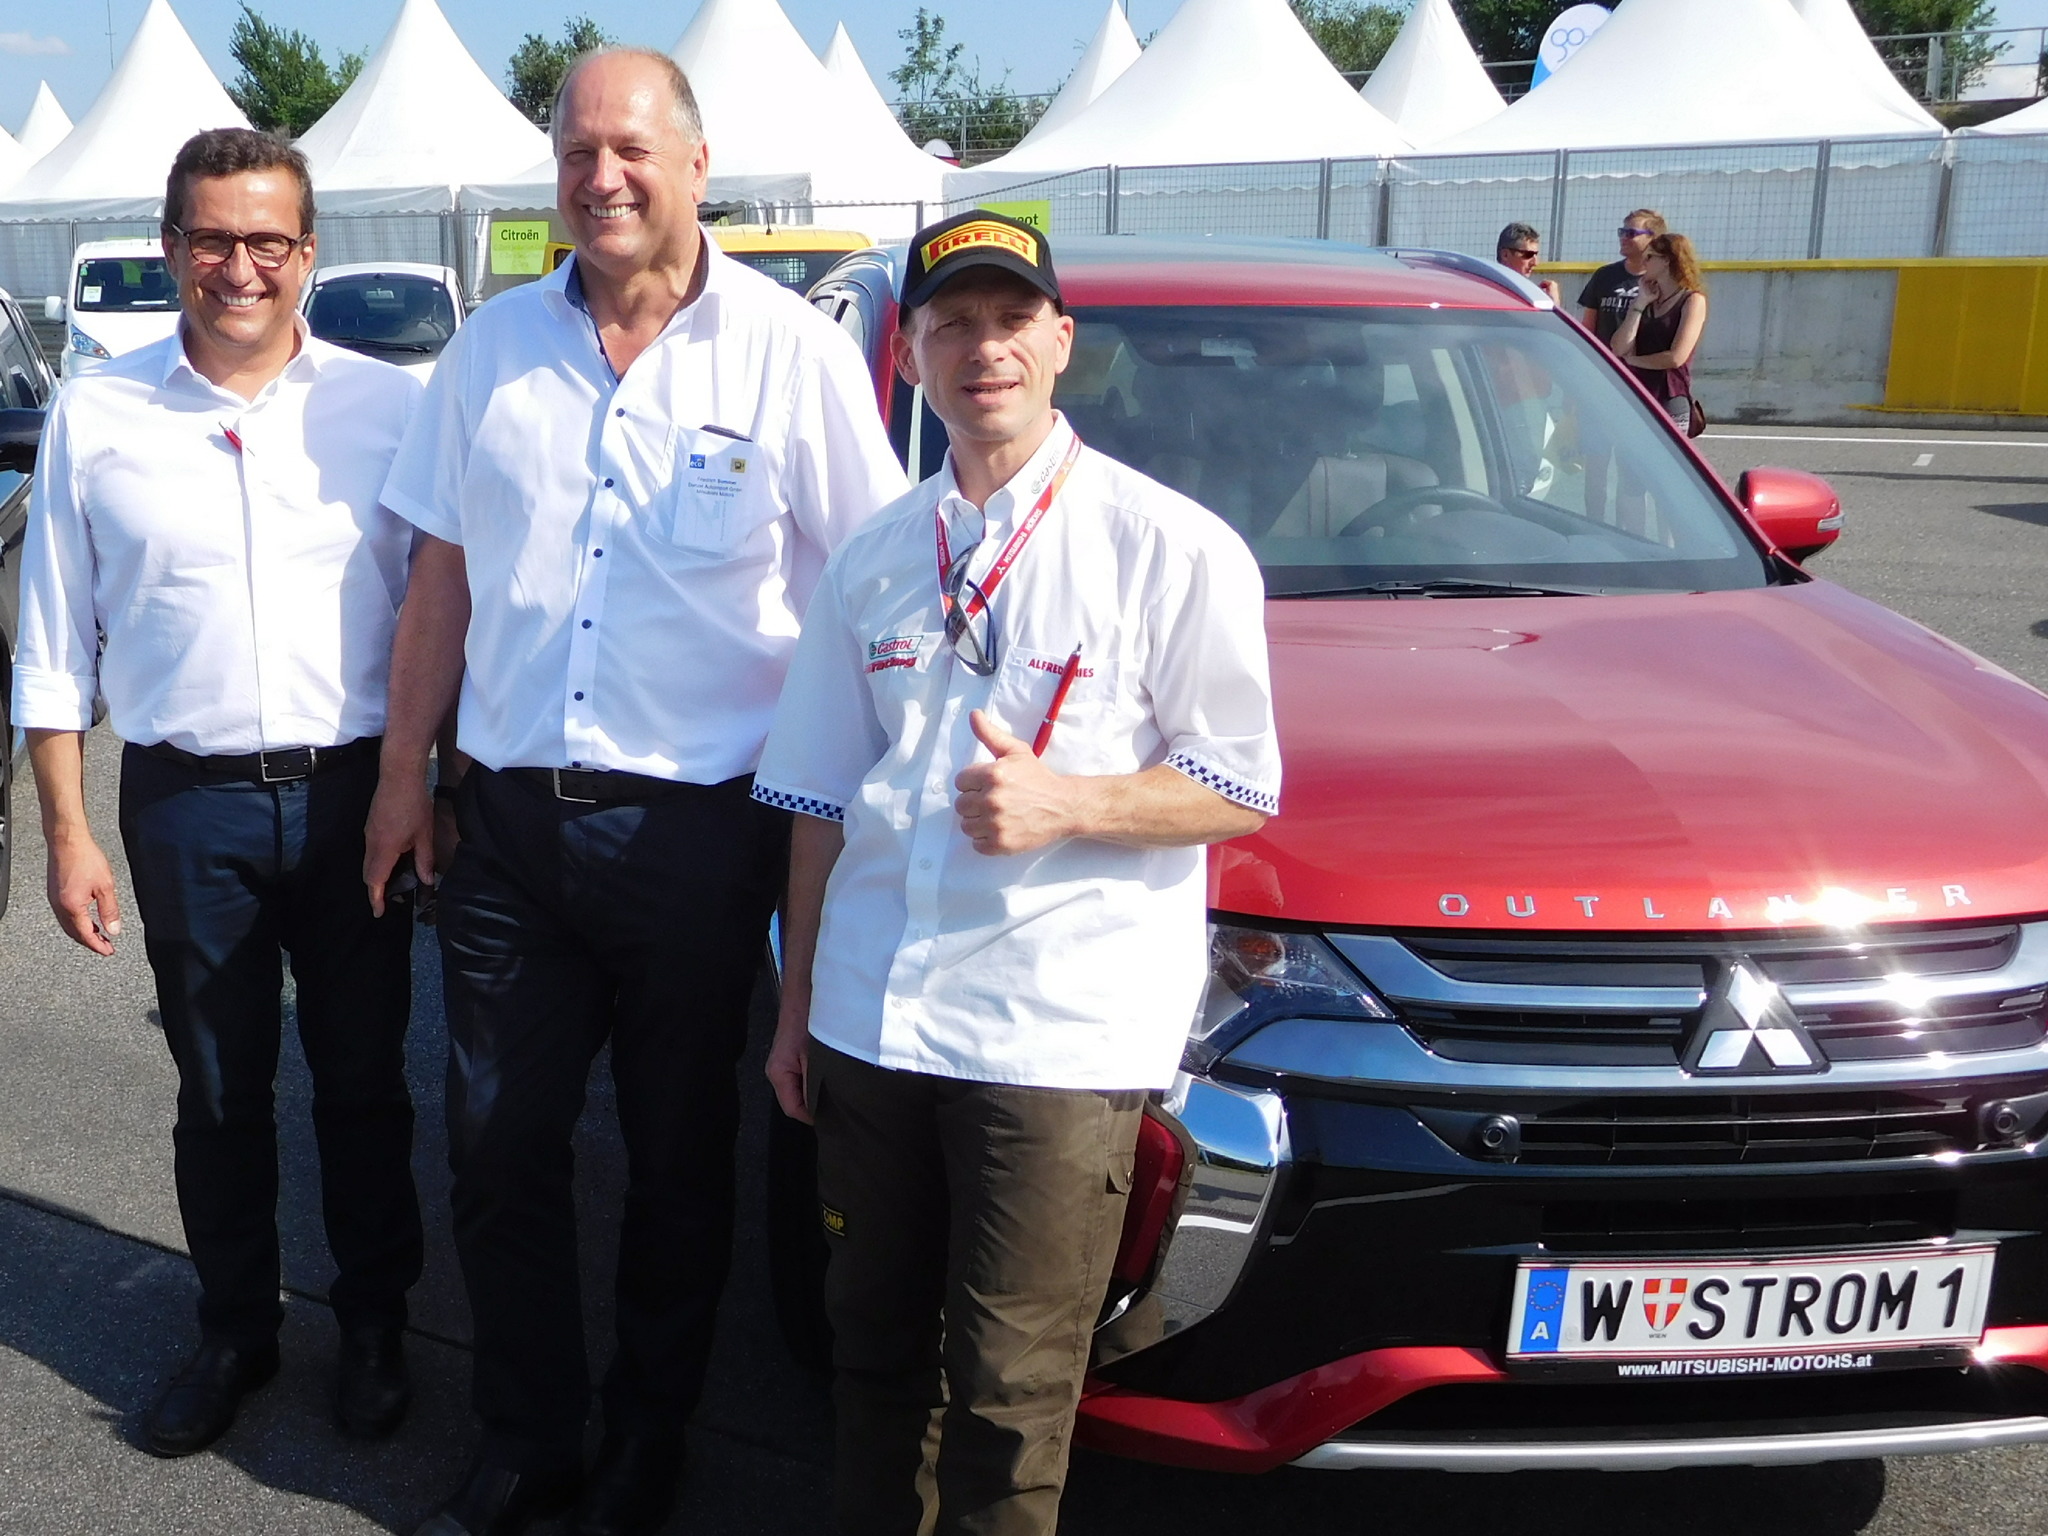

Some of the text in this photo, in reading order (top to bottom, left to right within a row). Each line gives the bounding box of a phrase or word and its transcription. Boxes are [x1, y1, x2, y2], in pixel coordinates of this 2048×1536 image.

[500, 229, 539, 241] Citroën
[929, 224, 1030, 262] PIRELLI
[877, 638, 913, 654] Castrol
[1027, 658, 1064, 675] ALFRED
[1437, 884, 1973, 921] OUTLANER
[1582, 1266, 1965, 1342] W STROM 1
[1530, 1321, 1549, 1340] A
